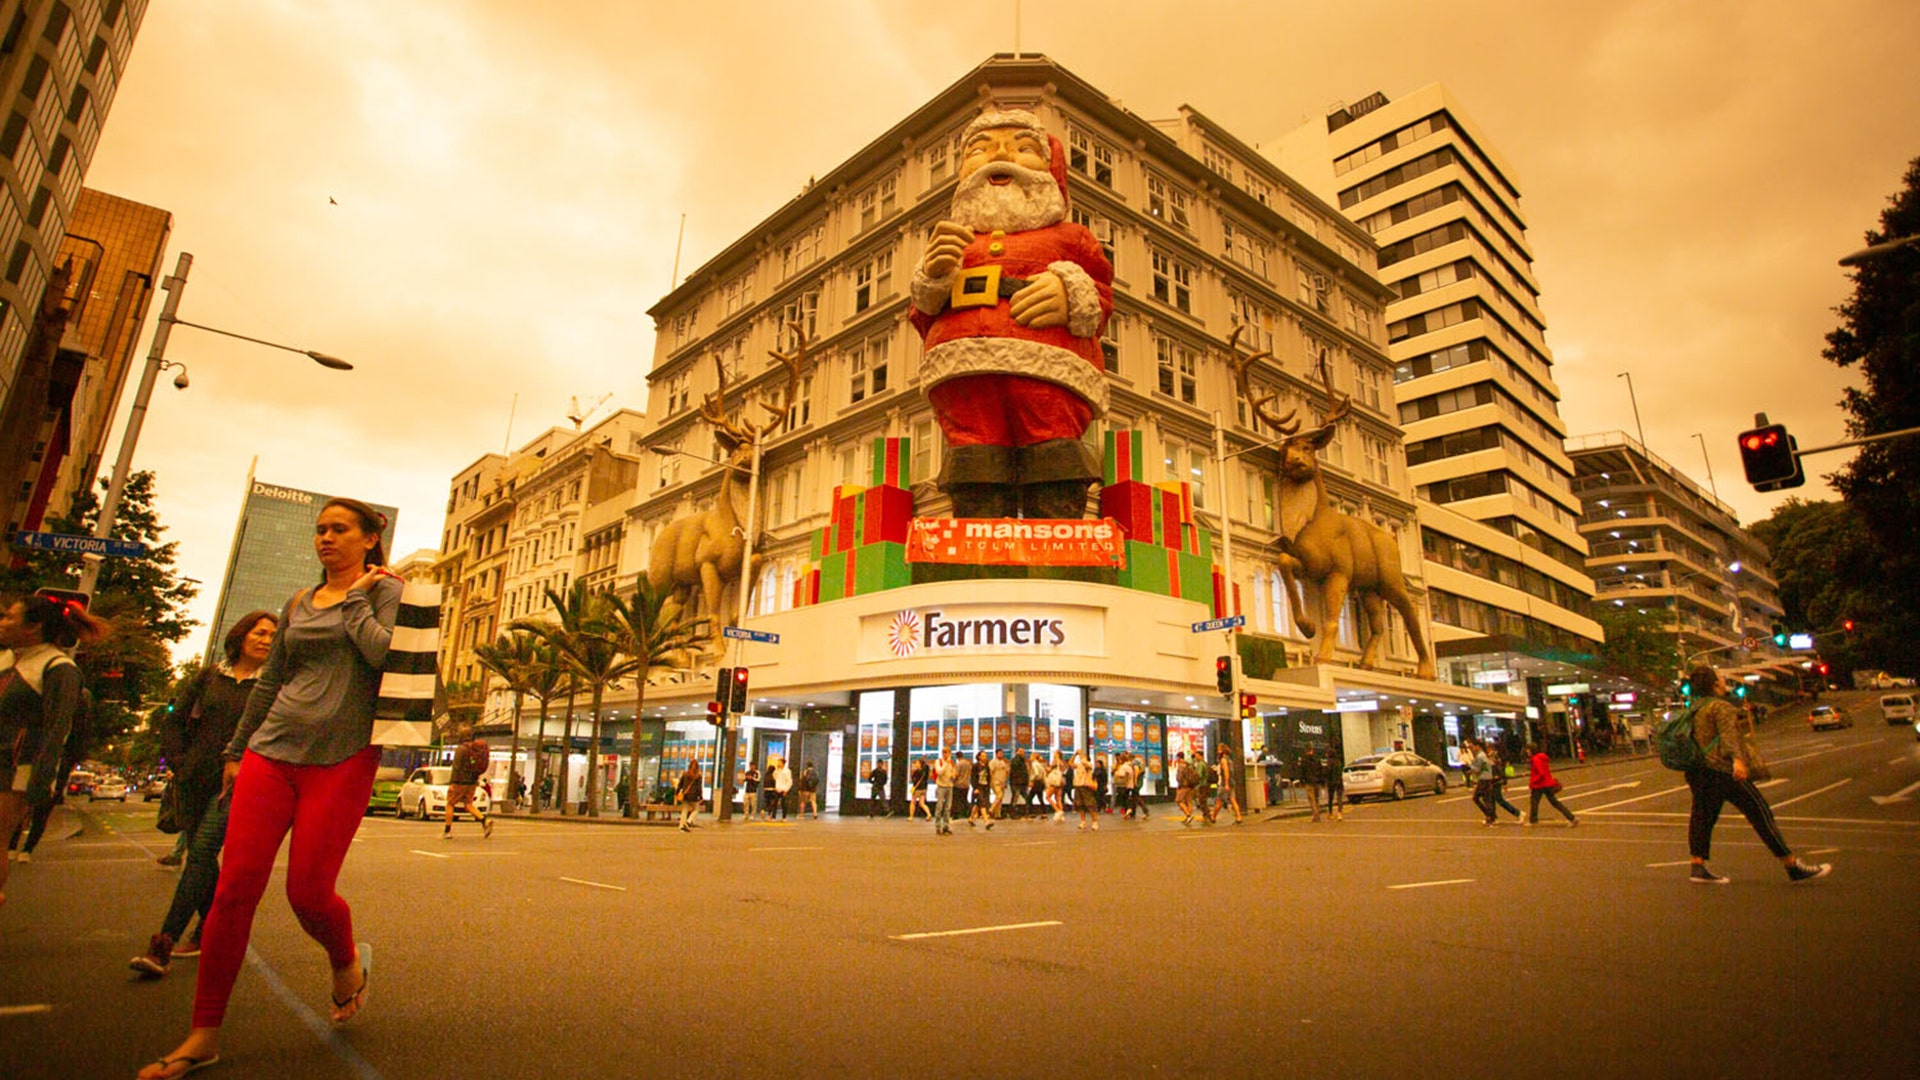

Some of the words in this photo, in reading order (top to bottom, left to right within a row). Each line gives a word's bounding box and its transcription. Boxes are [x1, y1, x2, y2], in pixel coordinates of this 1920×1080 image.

[253, 484, 312, 503] Deloitte
[966, 522, 1112, 539] mansons
[53, 537, 107, 552] VICTORIA
[967, 541, 1014, 550] TCLM
[1031, 541, 1114, 551] LIMITED
[924, 612, 1065, 647] Farmers
